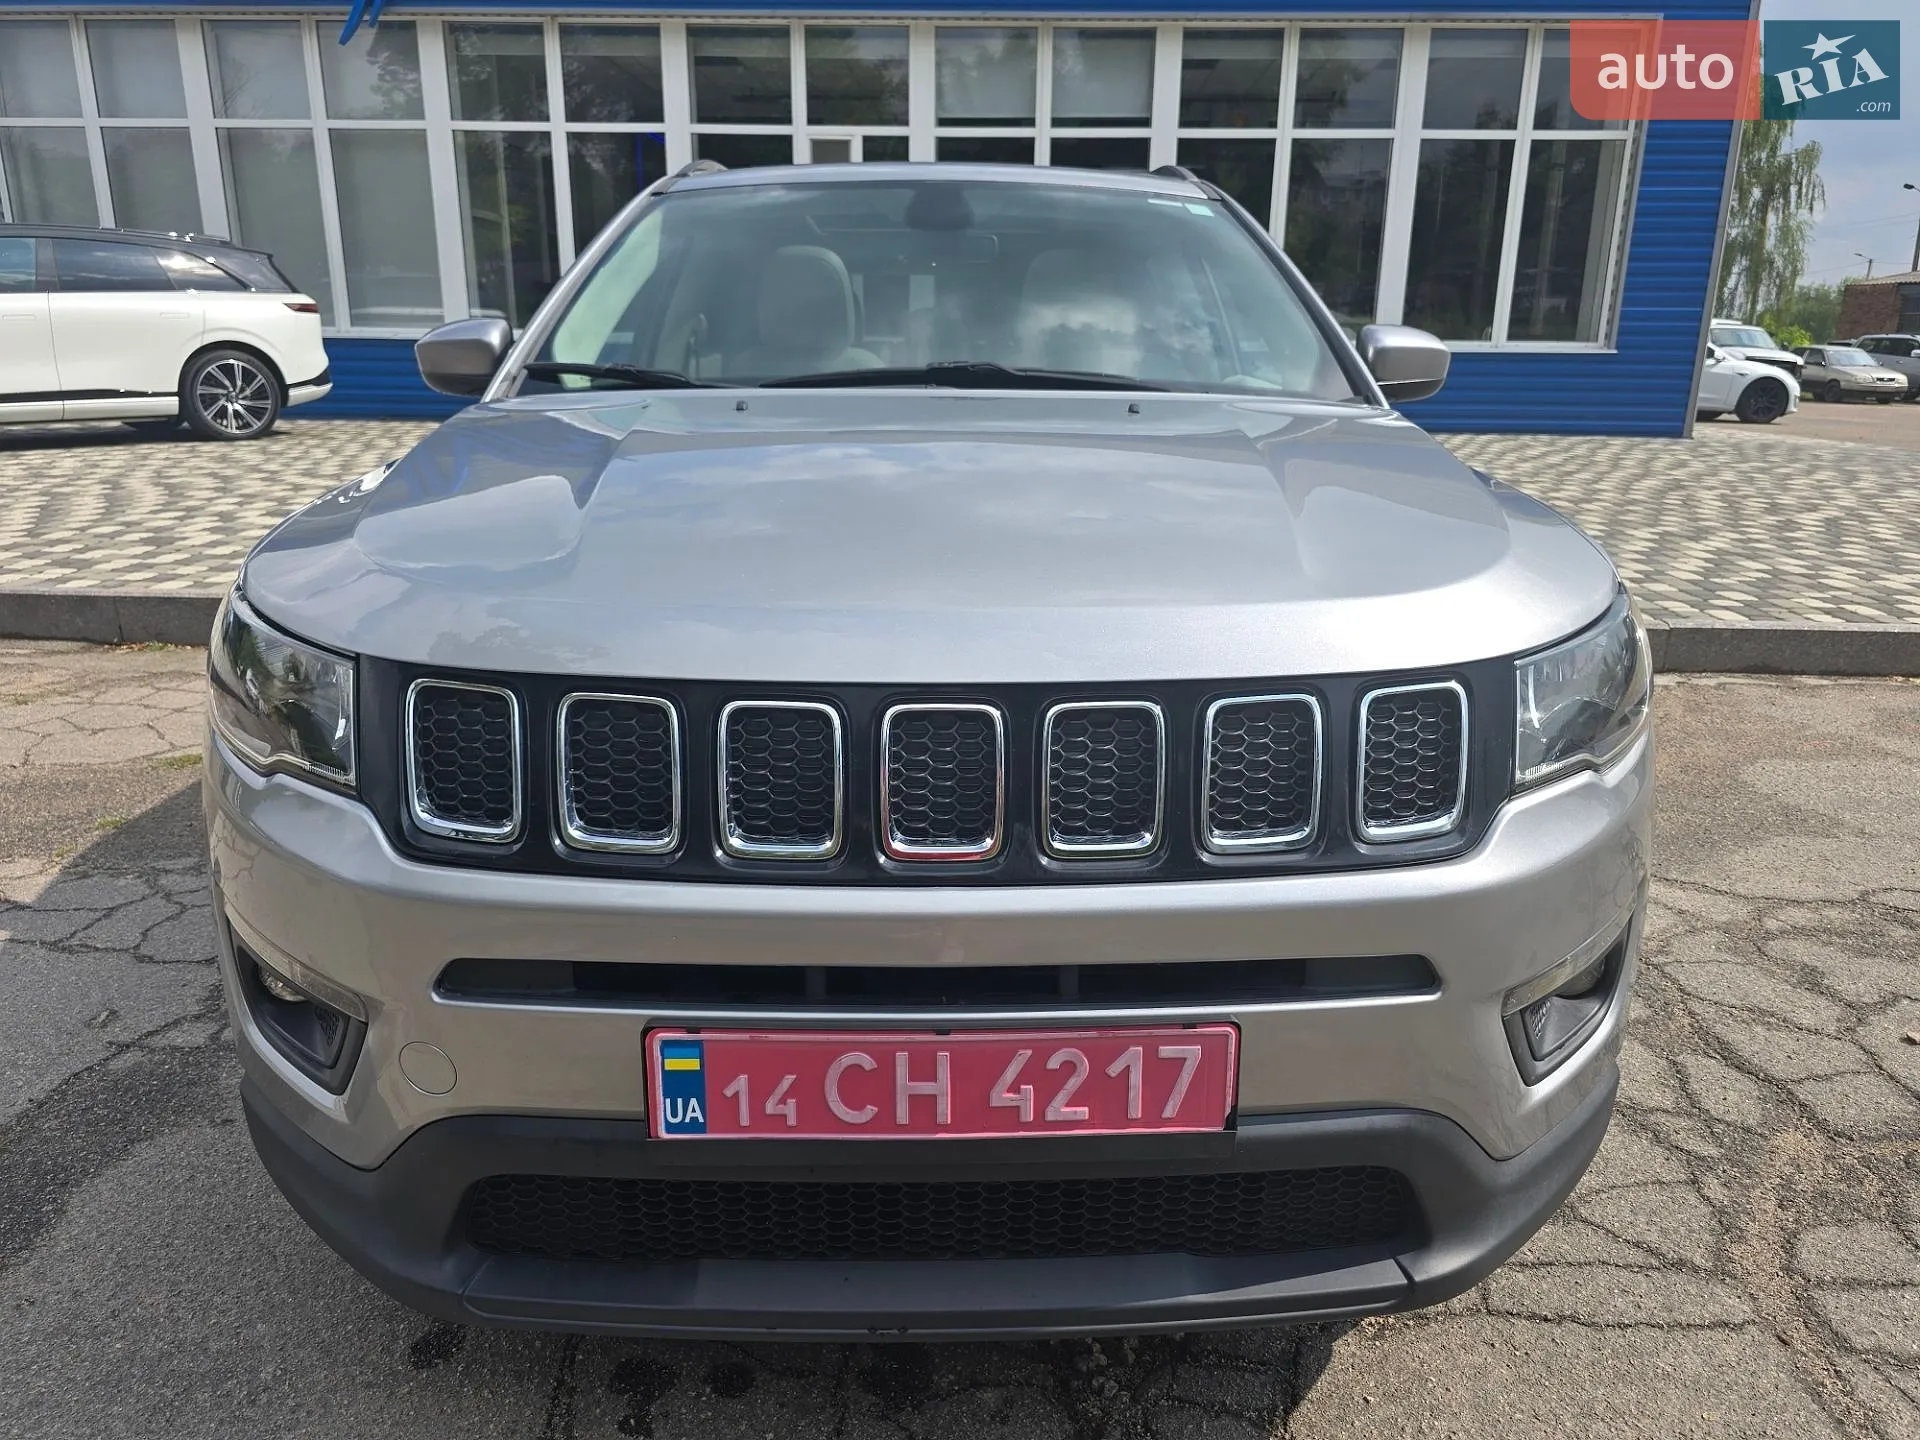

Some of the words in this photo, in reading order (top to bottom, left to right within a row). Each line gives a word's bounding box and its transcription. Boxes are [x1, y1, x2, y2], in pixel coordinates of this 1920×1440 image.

[664, 1097, 705, 1124] UA
[722, 1074, 798, 1127] 14
[824, 1051, 951, 1125] CH
[989, 1045, 1202, 1122] 4217
